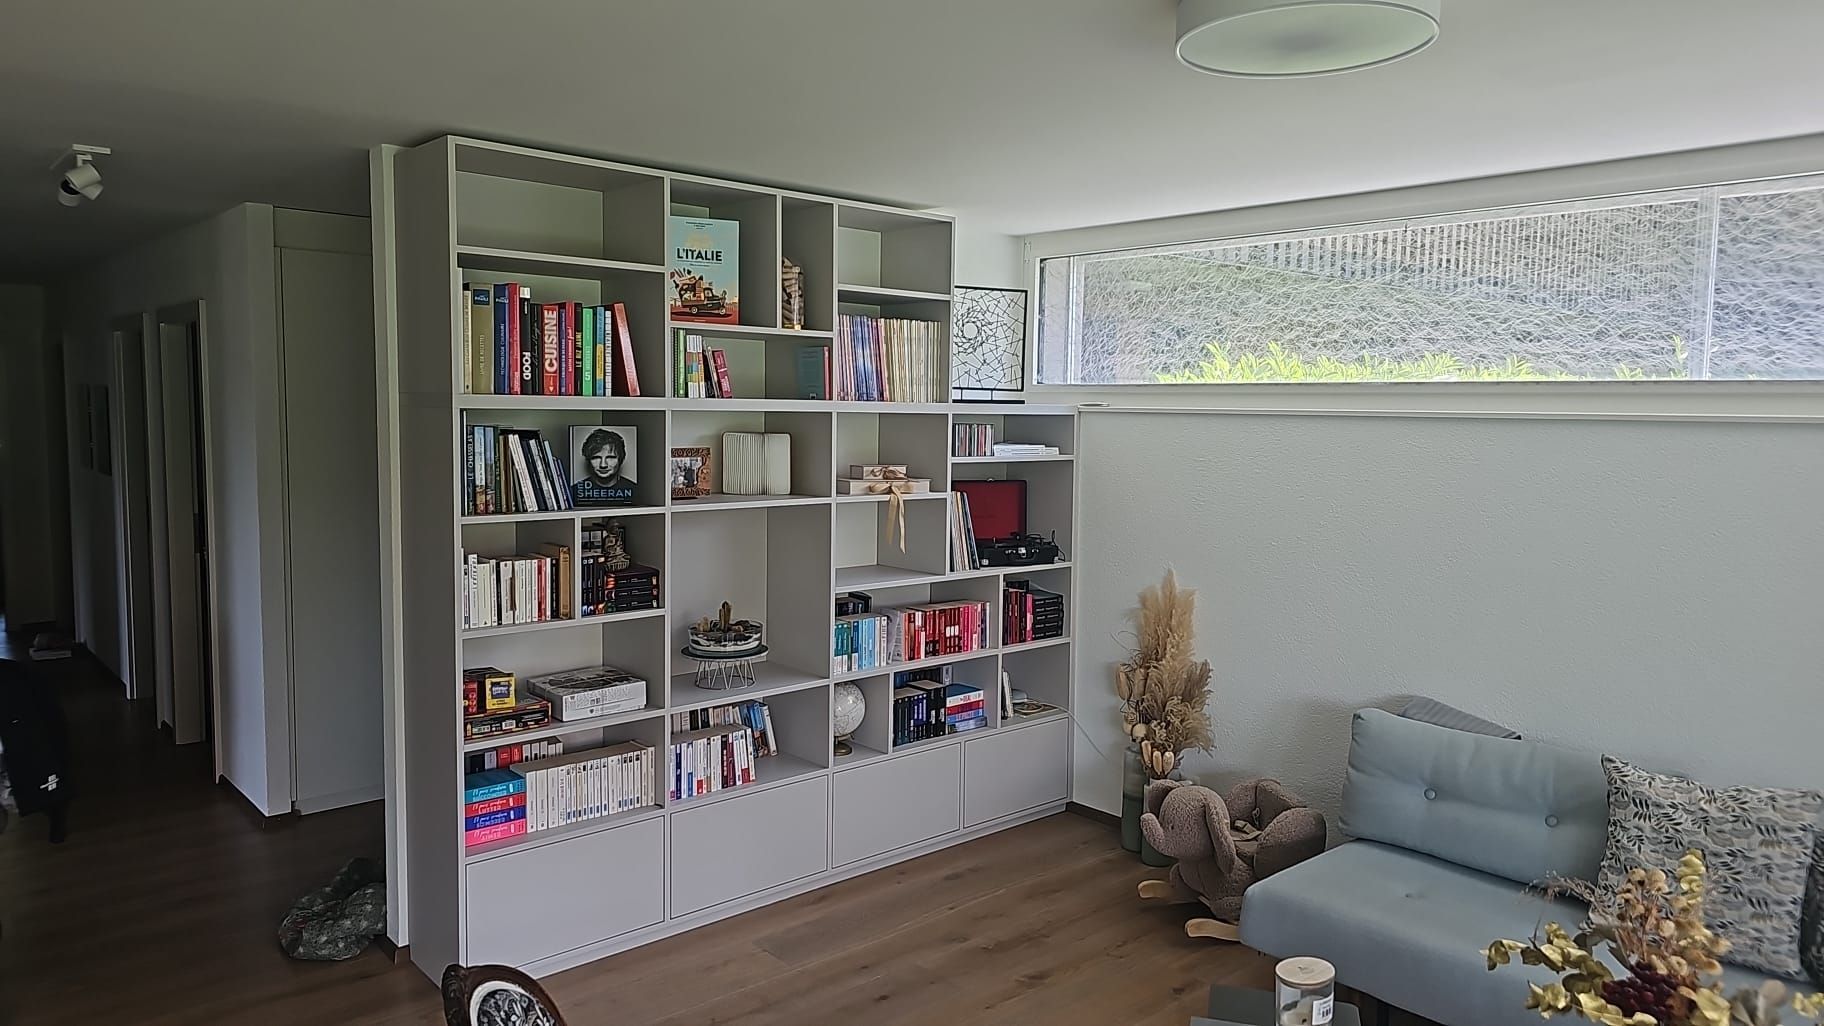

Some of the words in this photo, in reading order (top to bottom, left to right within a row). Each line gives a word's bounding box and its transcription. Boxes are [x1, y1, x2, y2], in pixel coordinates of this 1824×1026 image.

[677, 247, 722, 261] L'ITALIE
[544, 309, 558, 373] CUISINE
[522, 351, 531, 380] FOOD
[585, 371, 591, 381] 5
[467, 472, 474, 480] LE
[577, 479, 593, 489] ED
[577, 489, 632, 498] SHEERAN
